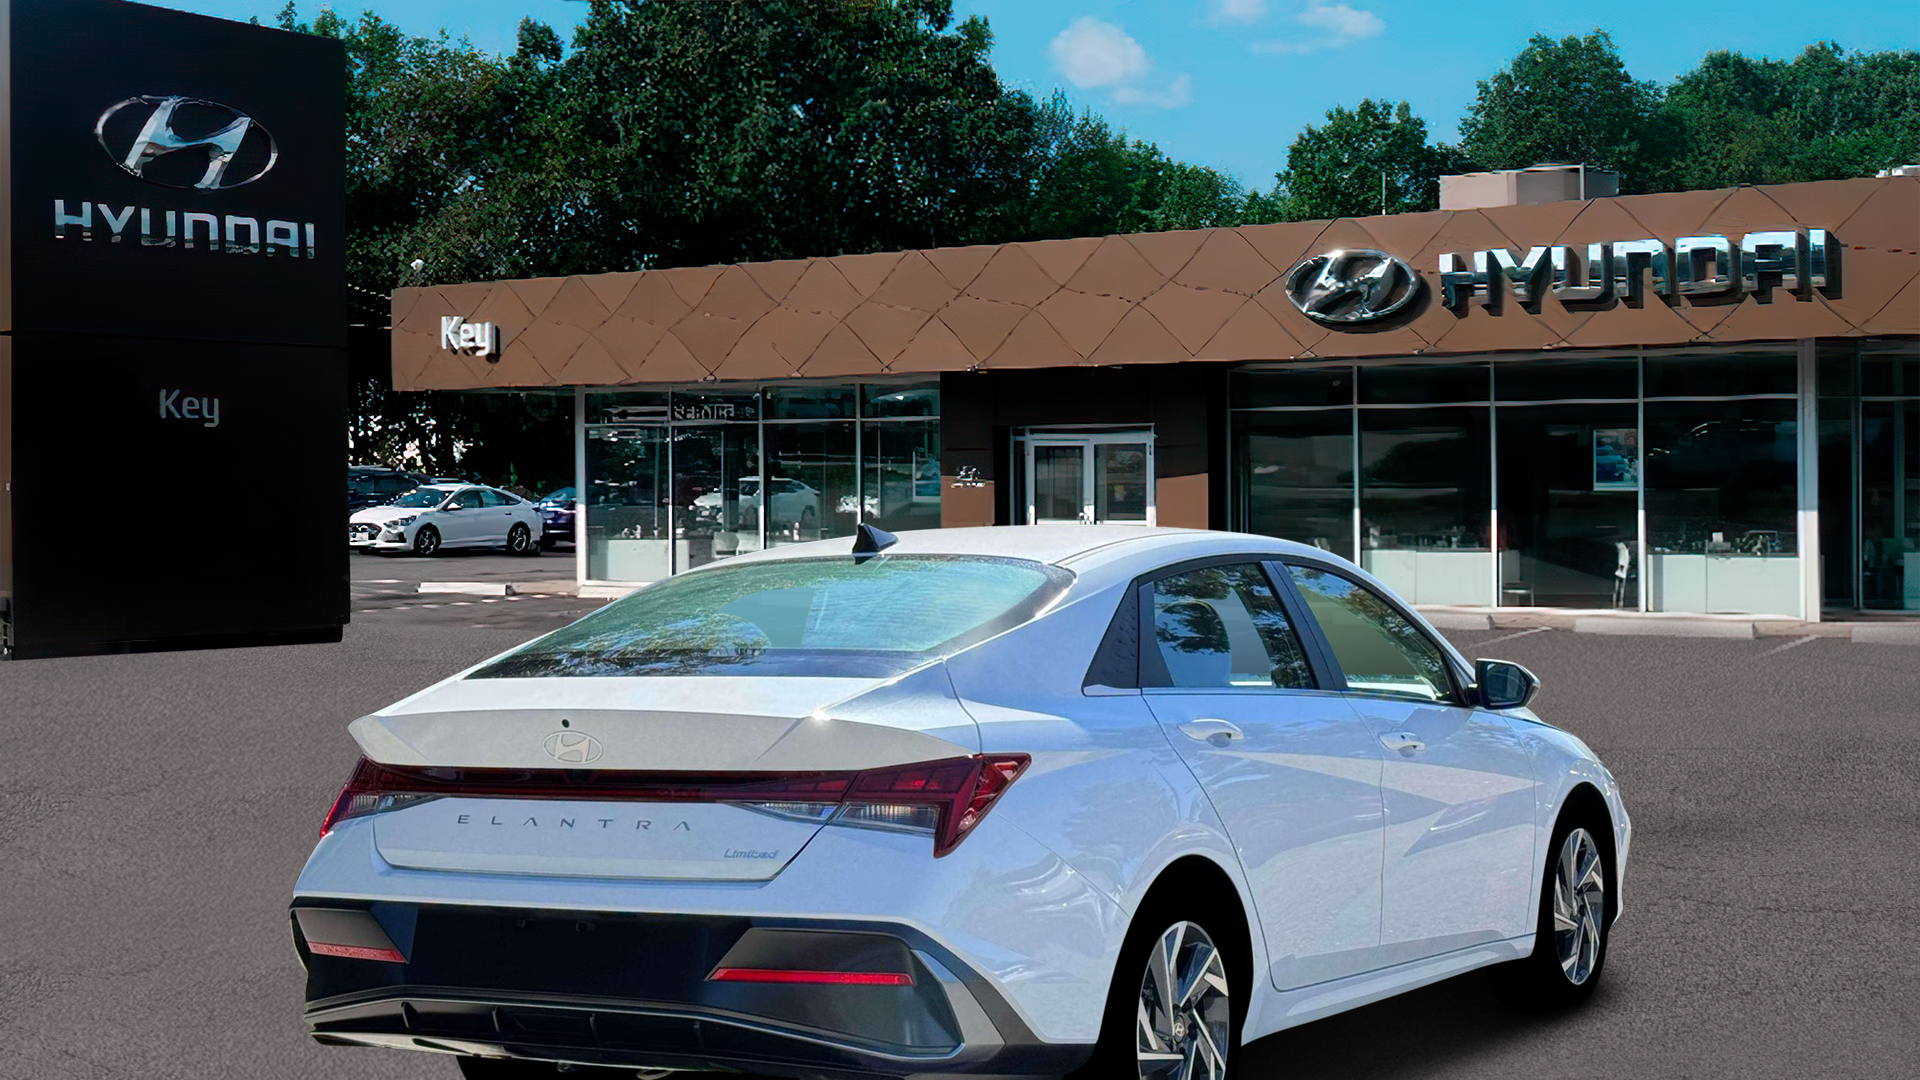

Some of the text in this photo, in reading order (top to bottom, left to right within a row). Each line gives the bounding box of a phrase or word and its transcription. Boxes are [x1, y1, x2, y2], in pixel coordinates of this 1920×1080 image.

[54, 199, 315, 260] HYUNDAI
[1438, 228, 1840, 314] HYUNDAI
[441, 315, 493, 357] Key
[158, 388, 220, 428] Key
[457, 814, 691, 832] ELANTRA
[723, 848, 778, 860] Limited
